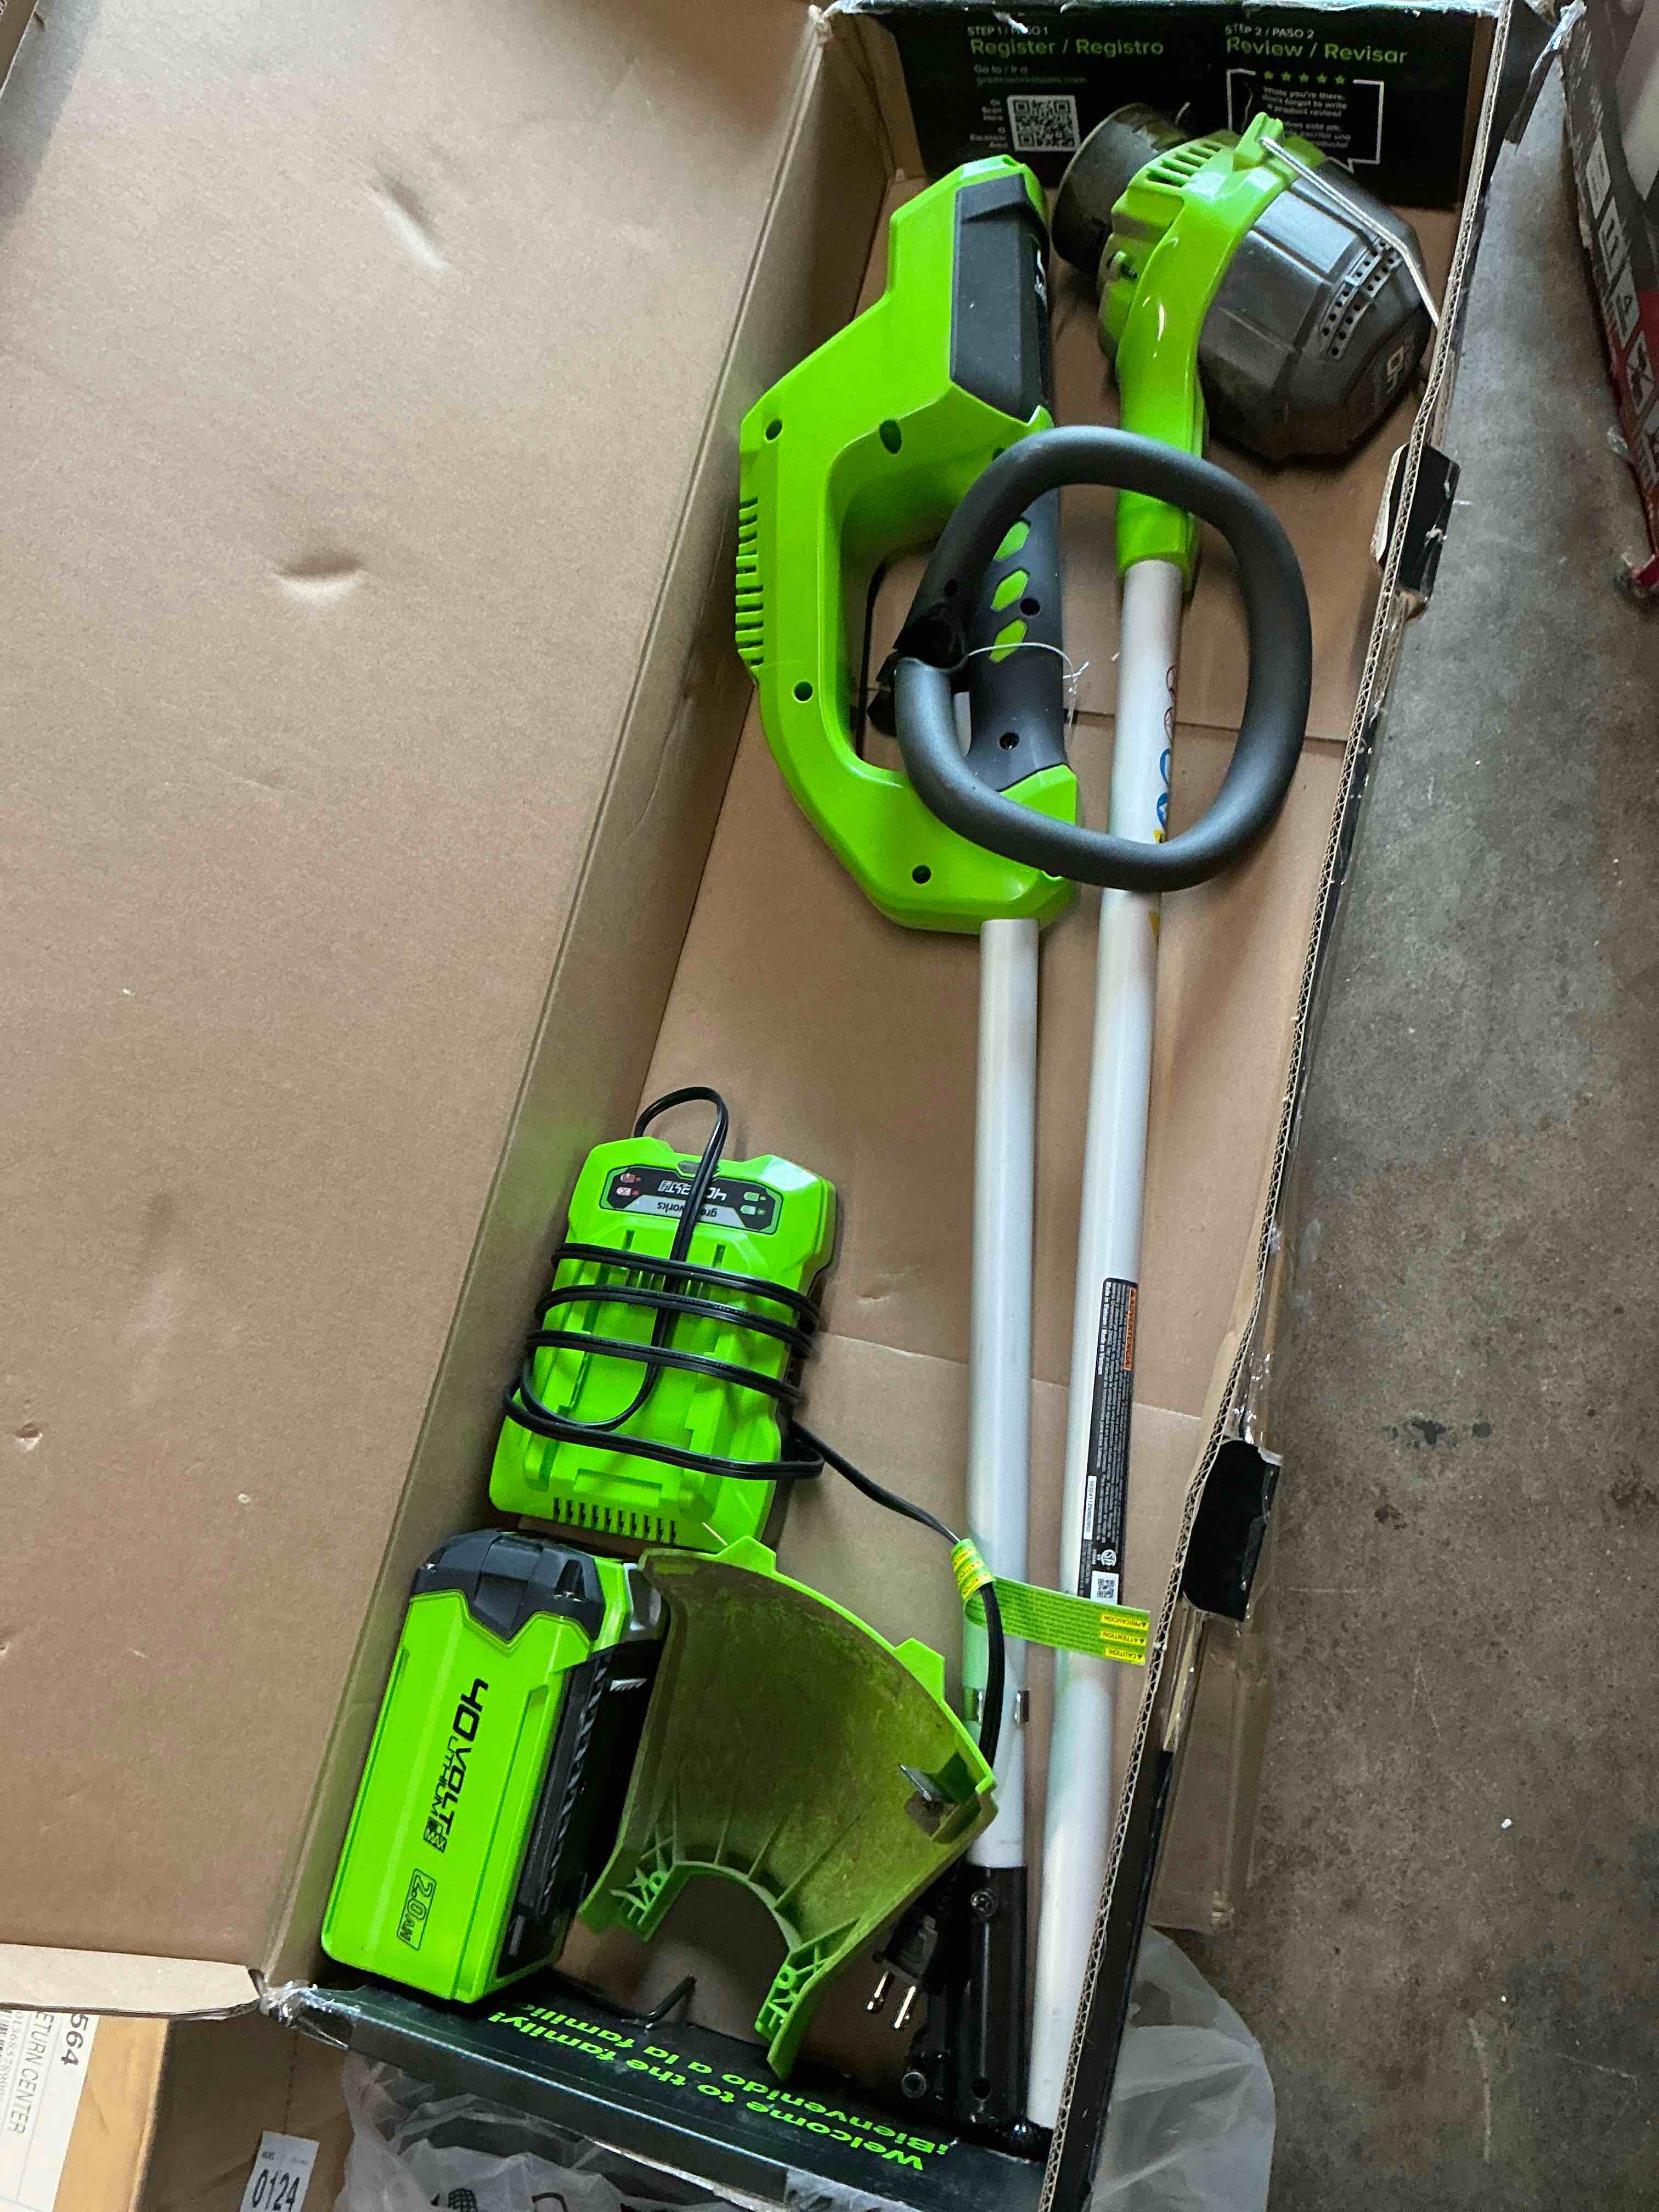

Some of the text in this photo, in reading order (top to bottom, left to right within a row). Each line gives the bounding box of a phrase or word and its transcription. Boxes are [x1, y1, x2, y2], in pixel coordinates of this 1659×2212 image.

[1225, 22, 1251, 35] STEP
[1255, 26, 1262, 37] 2
[1272, 27, 1304, 40] PASO
[1306, 29, 1314, 40] 2
[970, 39, 1164, 58] Register / Registro
[1226, 36, 1408, 64] Review / Revisar
[1109, 1649, 1137, 1658] CAUTION
[438, 1677, 489, 1836] 40 VOLT
[644, 2045, 679, 2064] la
[687, 2061, 713, 2074] a
[7, 2068, 39, 2134] CENTER
[487, 2011, 923, 2171] Welcome to the family!
[722, 2073, 950, 2156] ¡Bienvenido
[252, 2168, 300, 2212] 0124
